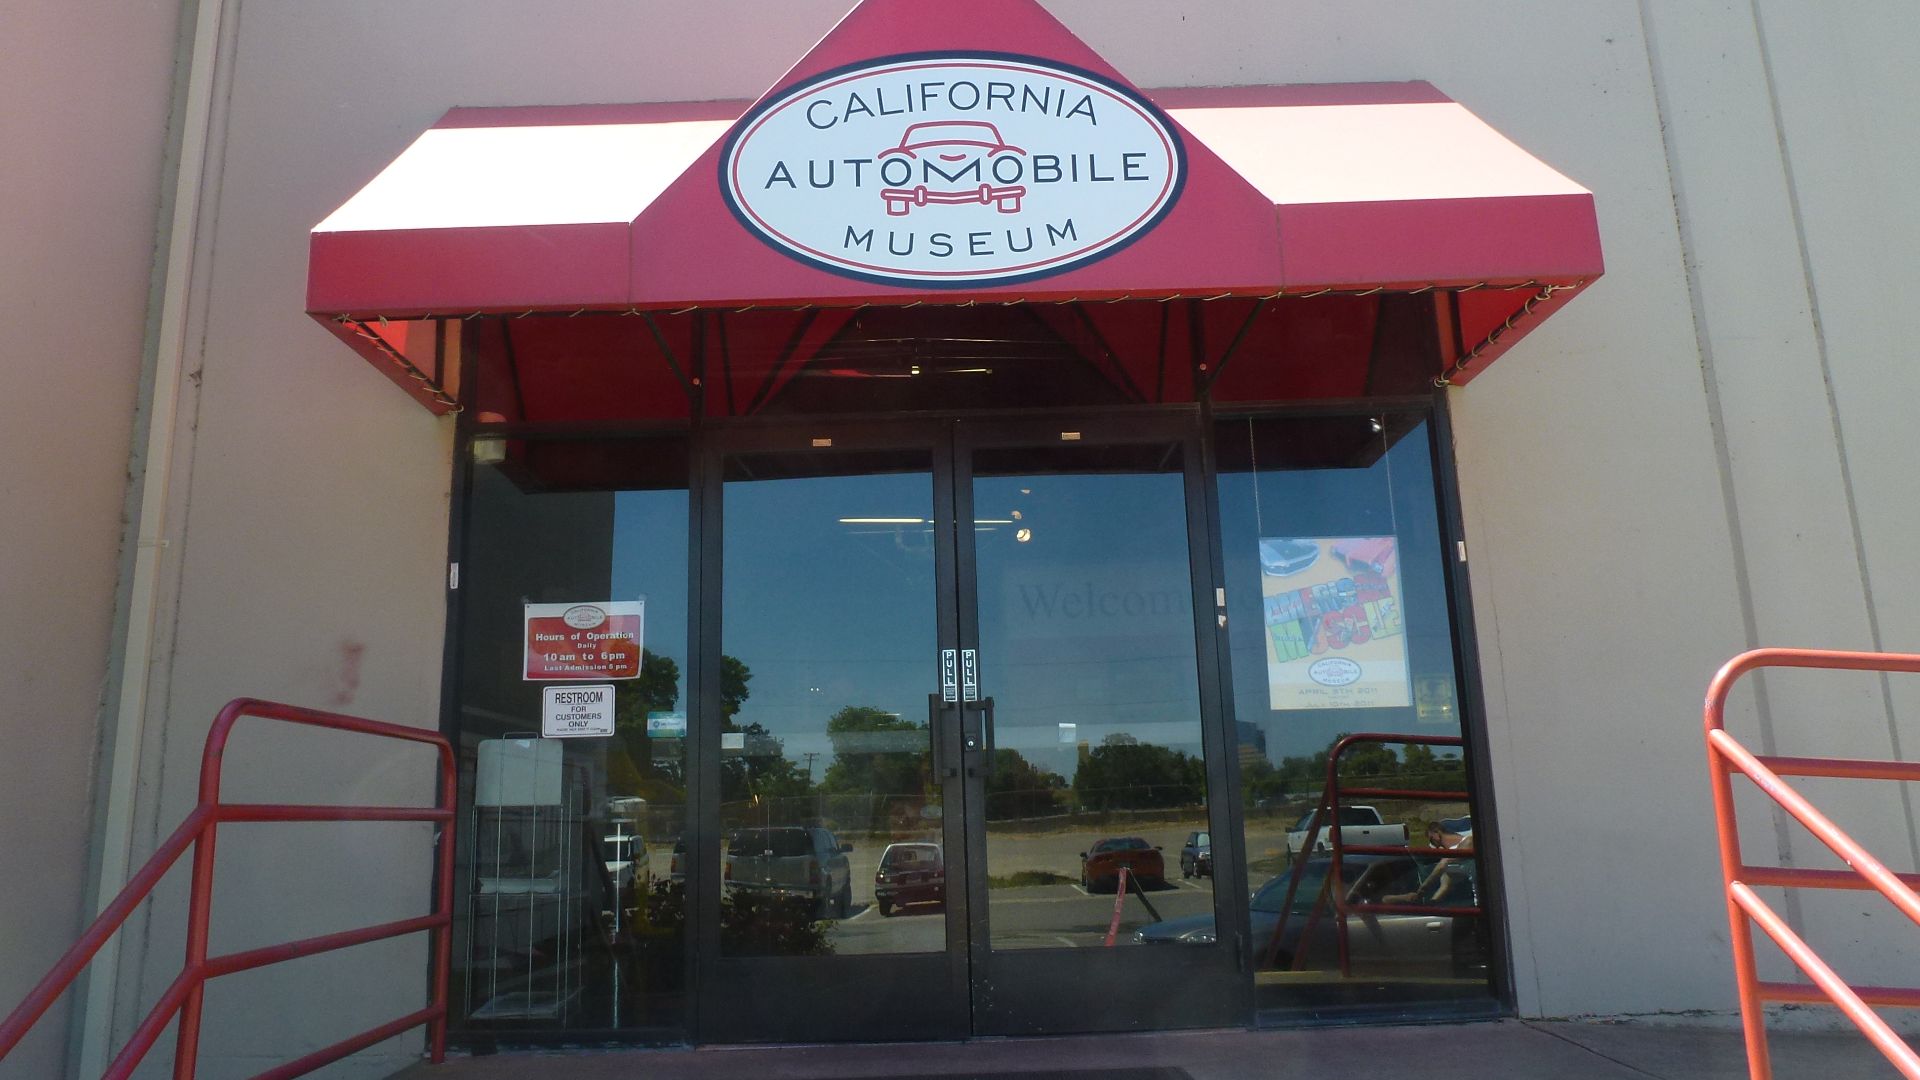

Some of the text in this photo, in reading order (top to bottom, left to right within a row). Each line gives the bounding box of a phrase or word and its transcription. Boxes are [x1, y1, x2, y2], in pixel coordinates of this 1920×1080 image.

[806, 81, 1098, 130] CALIFORNIA
[764, 152, 1150, 190] AUTOMOBILE
[844, 218, 1078, 258] MUSEUM
[1018, 581, 1187, 620] Welcom
[535, 631, 634, 642] Hours of Operation
[582, 652, 594, 661] to
[946, 651, 954, 684] PULL
[965, 651, 973, 684] PULL
[555, 691, 603, 704] RESTROOM
[571, 705, 587, 713] FOR
[555, 713, 602, 721] CUSTOMERS
[568, 720, 589, 728] ONLY
